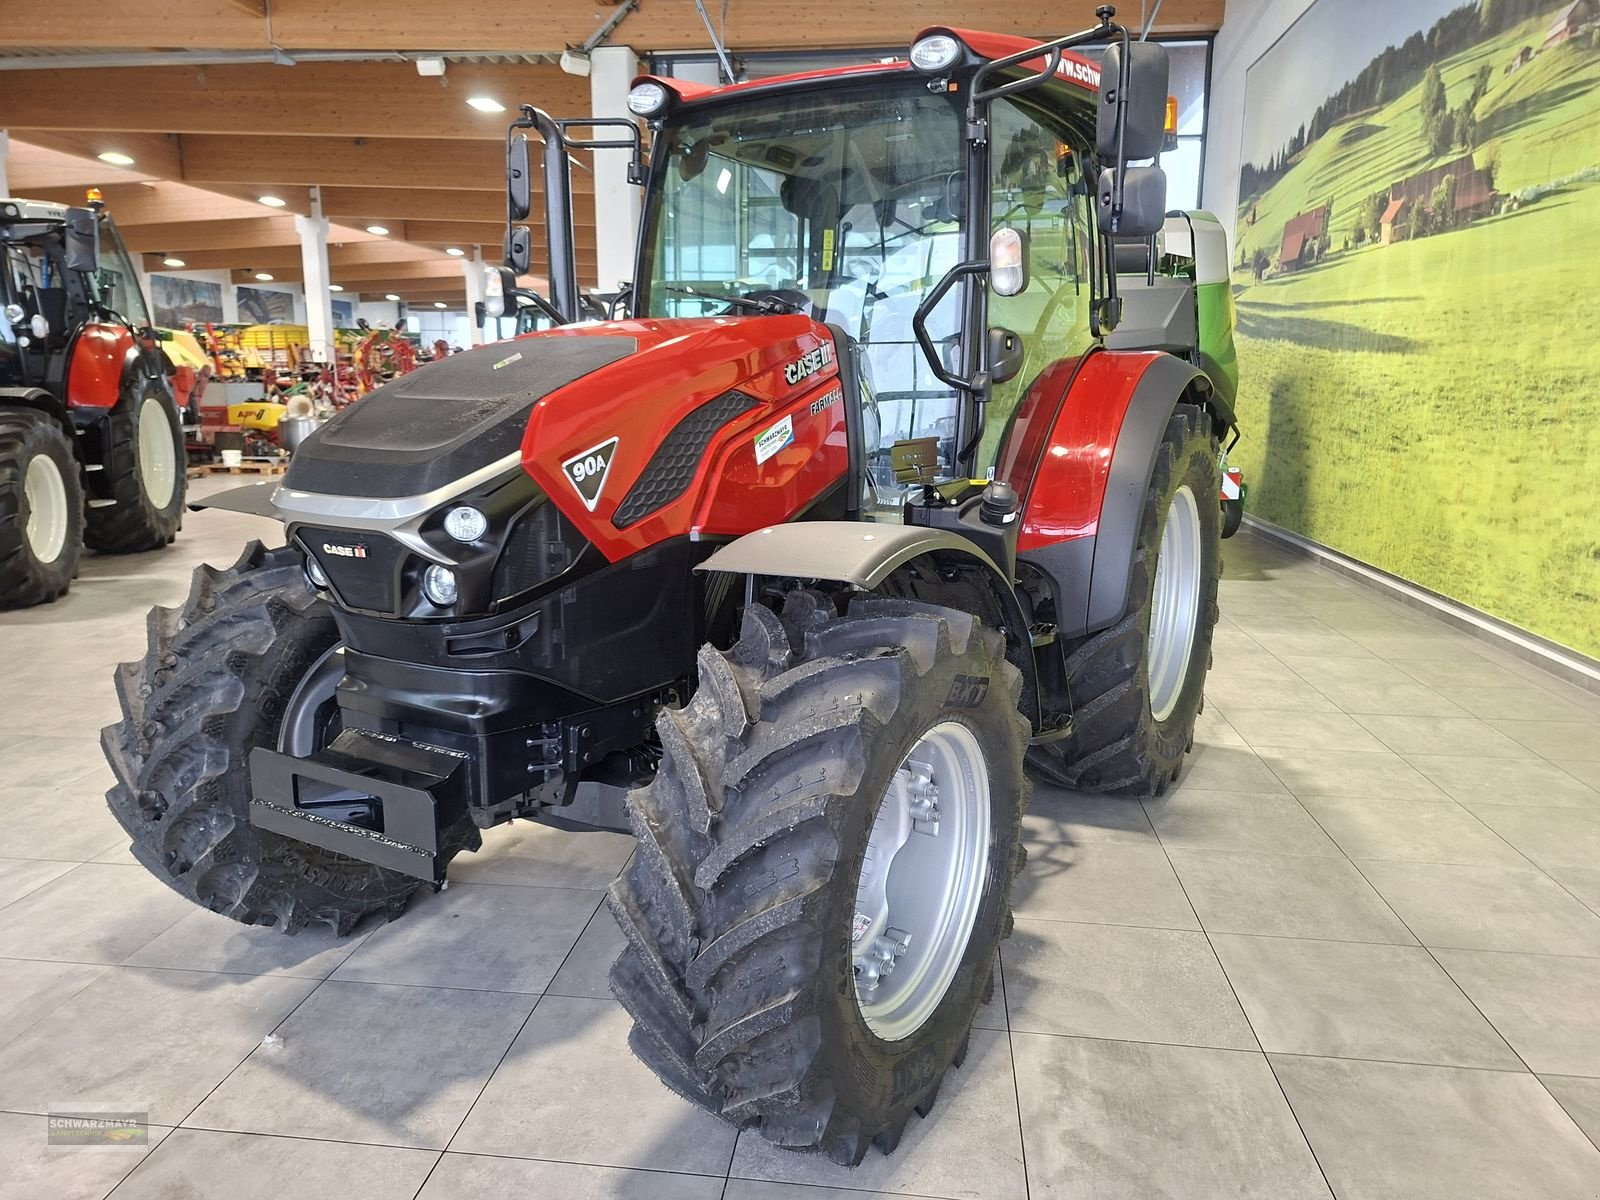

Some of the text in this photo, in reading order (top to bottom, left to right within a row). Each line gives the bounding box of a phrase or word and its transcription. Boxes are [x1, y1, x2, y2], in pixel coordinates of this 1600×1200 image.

[785, 348, 821, 384] CASE
[572, 454, 607, 482] 90A
[322, 543, 354, 557] CASE
